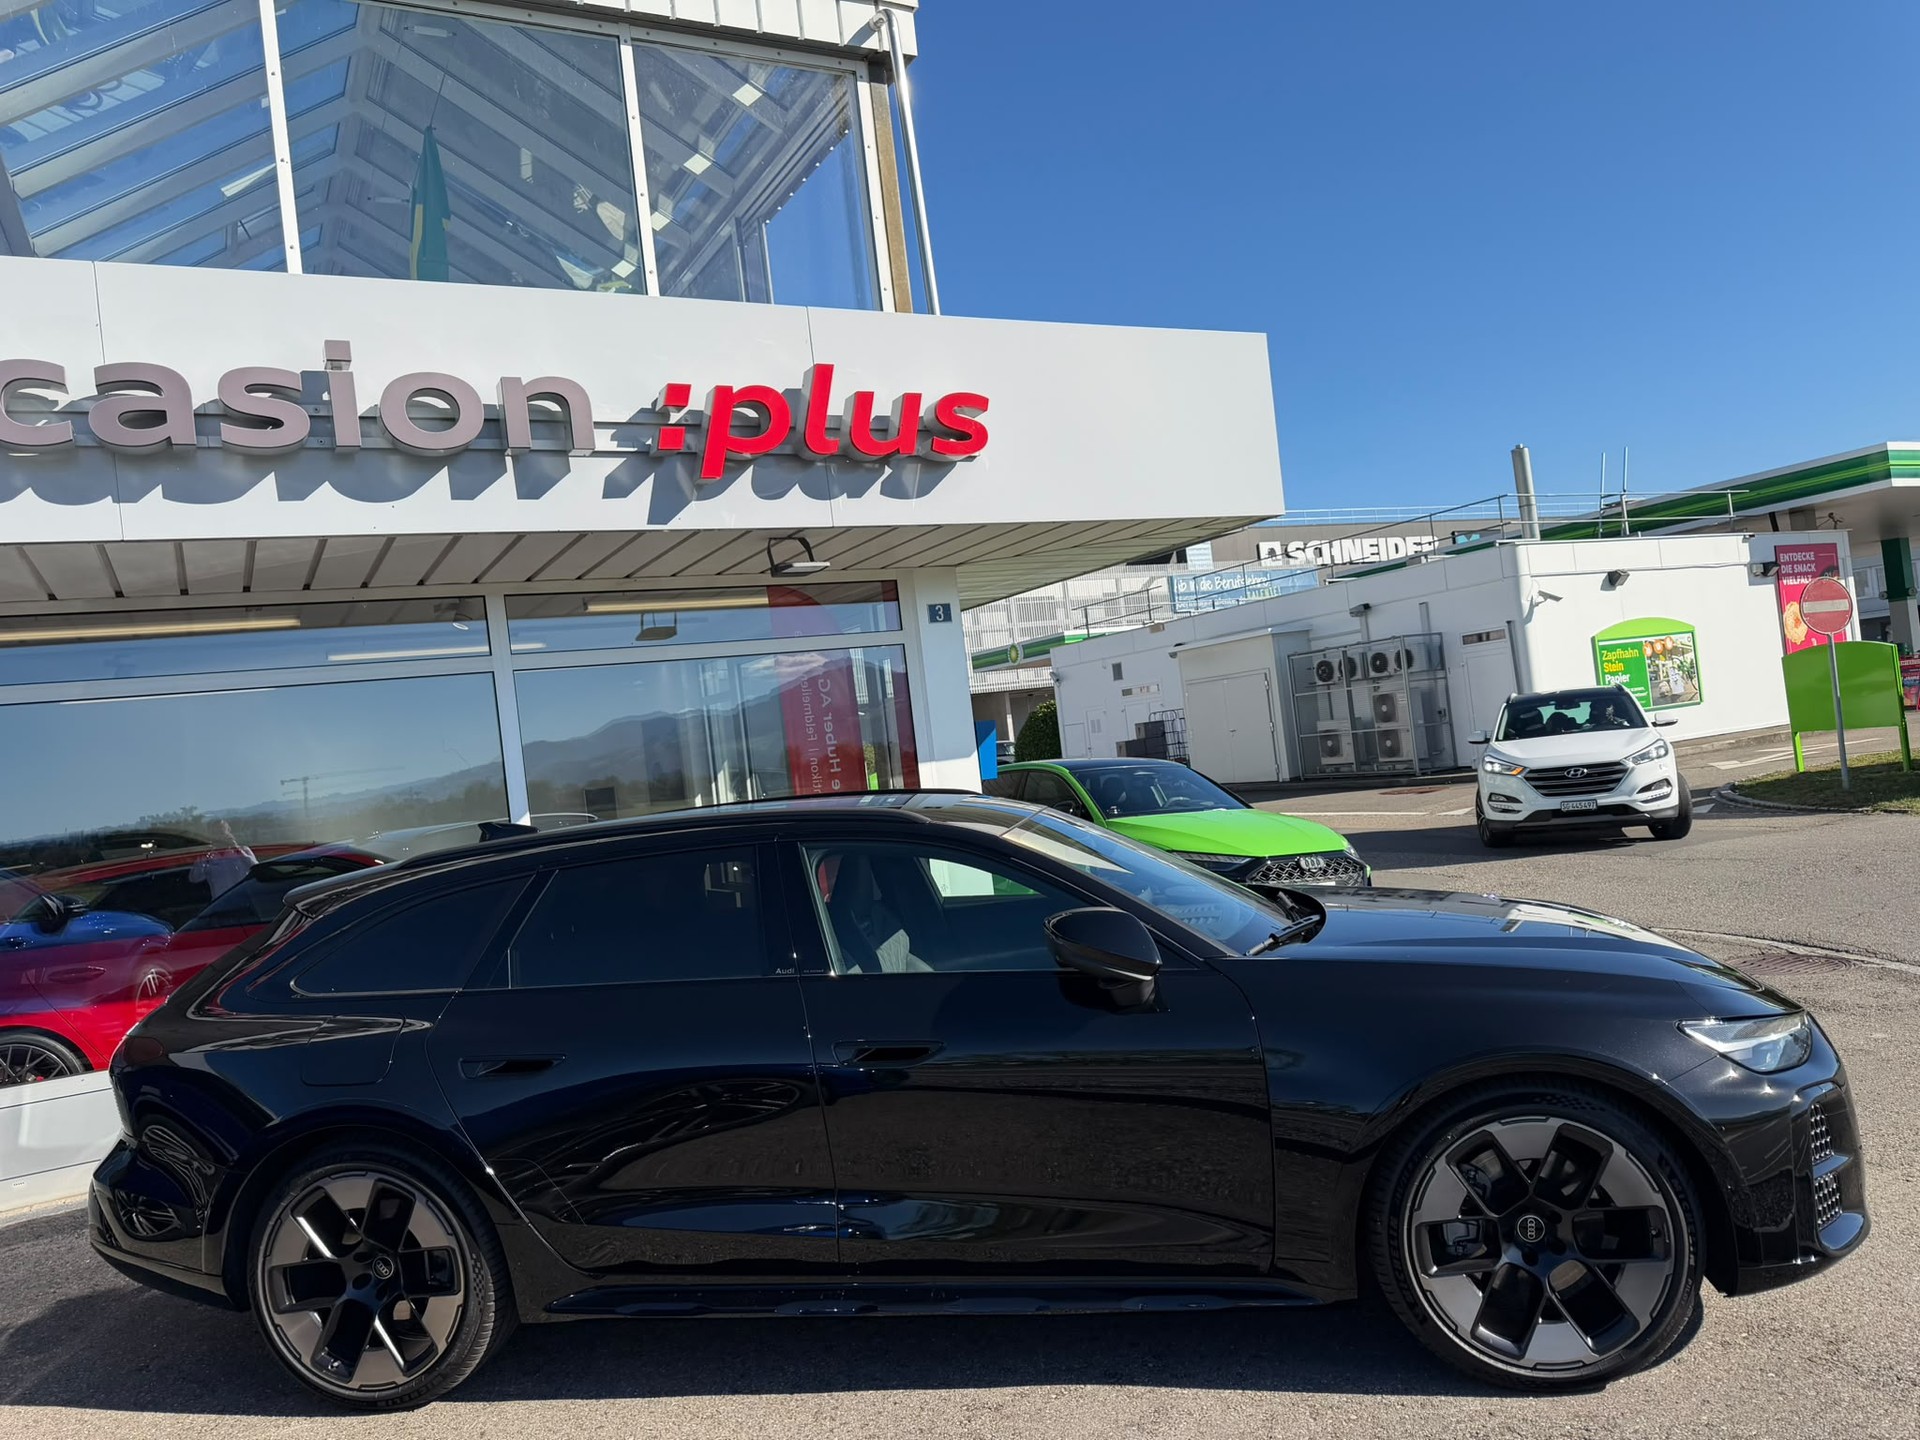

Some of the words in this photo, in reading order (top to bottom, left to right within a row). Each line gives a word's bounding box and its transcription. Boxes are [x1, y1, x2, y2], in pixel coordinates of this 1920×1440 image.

[1287, 536, 1439, 565] SCHNEIDER
[1780, 552, 1815, 562] ENTDECKE
[1781, 565, 1793, 574] DIE
[1794, 563, 1816, 573] SNACK
[935, 605, 944, 621] 3
[1601, 647, 1639, 662] Zapfhahn
[1603, 661, 1624, 673] Stein
[1604, 672, 1630, 685] Papier
[775, 967, 795, 975] Audi
